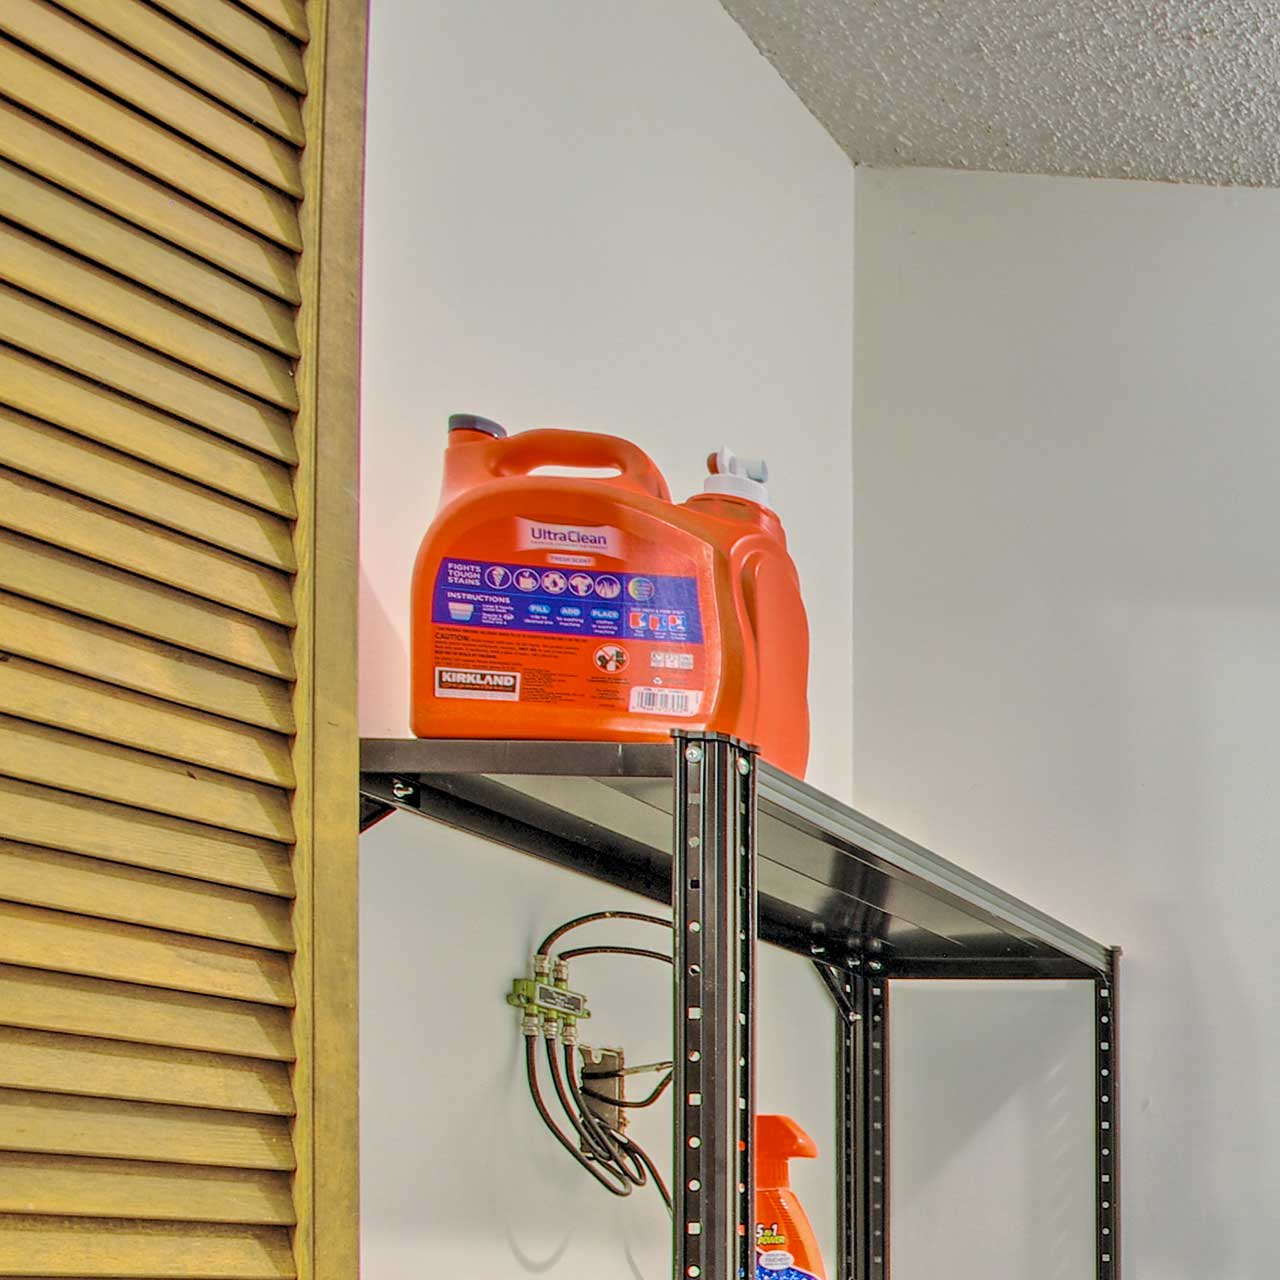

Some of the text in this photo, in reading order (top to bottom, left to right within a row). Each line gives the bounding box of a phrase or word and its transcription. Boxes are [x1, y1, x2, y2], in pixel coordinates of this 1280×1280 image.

[531, 527, 607, 545] UltraClean
[448, 563, 481, 572] FIGHTS
[448, 569, 480, 579] TOUGH
[448, 576, 480, 586] STAINS
[447, 591, 510, 604] INSTRUCTIONS
[442, 671, 515, 687] KIRKLAND
[758, 1235, 785, 1245] POWER
